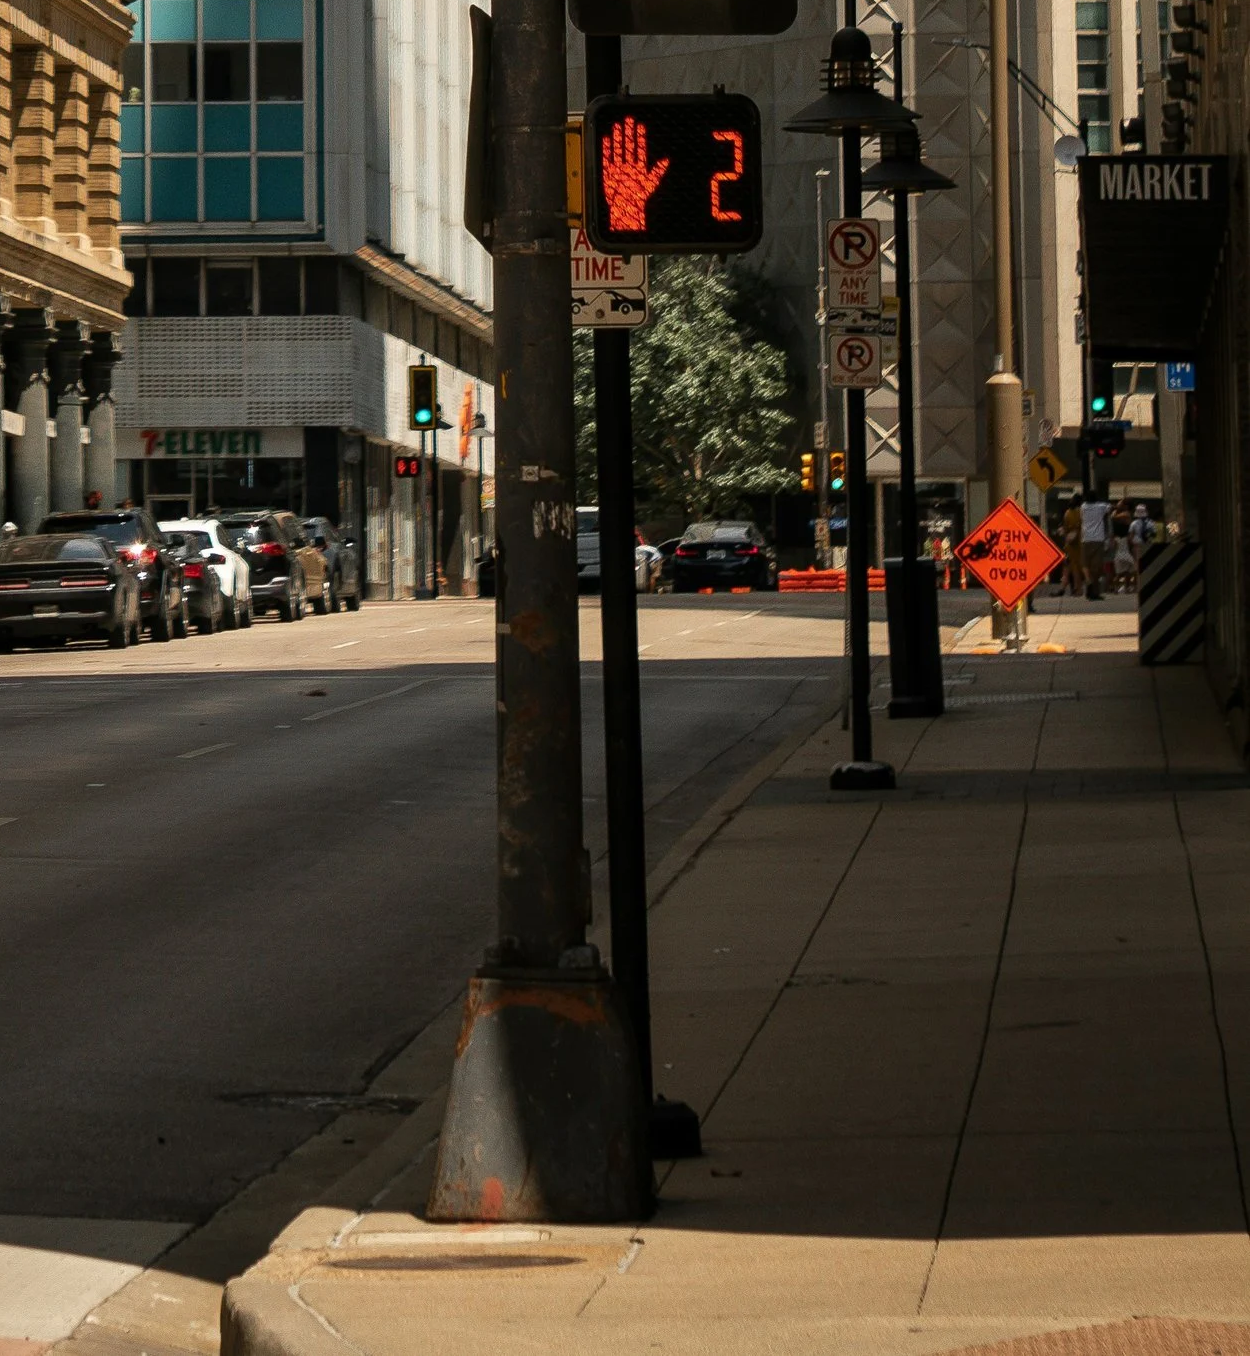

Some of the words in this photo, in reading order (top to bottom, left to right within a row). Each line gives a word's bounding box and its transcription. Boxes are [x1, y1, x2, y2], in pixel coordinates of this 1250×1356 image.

[710, 130, 743, 222] 2
[1100, 163, 1212, 201] MARKET
[571, 257, 624, 281] TIME
[839, 276, 870, 290] ANY
[838, 291, 870, 305] TIME
[984, 529, 1031, 543] AHEAD
[989, 548, 1028, 561] WORK
[989, 567, 1027, 581] ROAD
